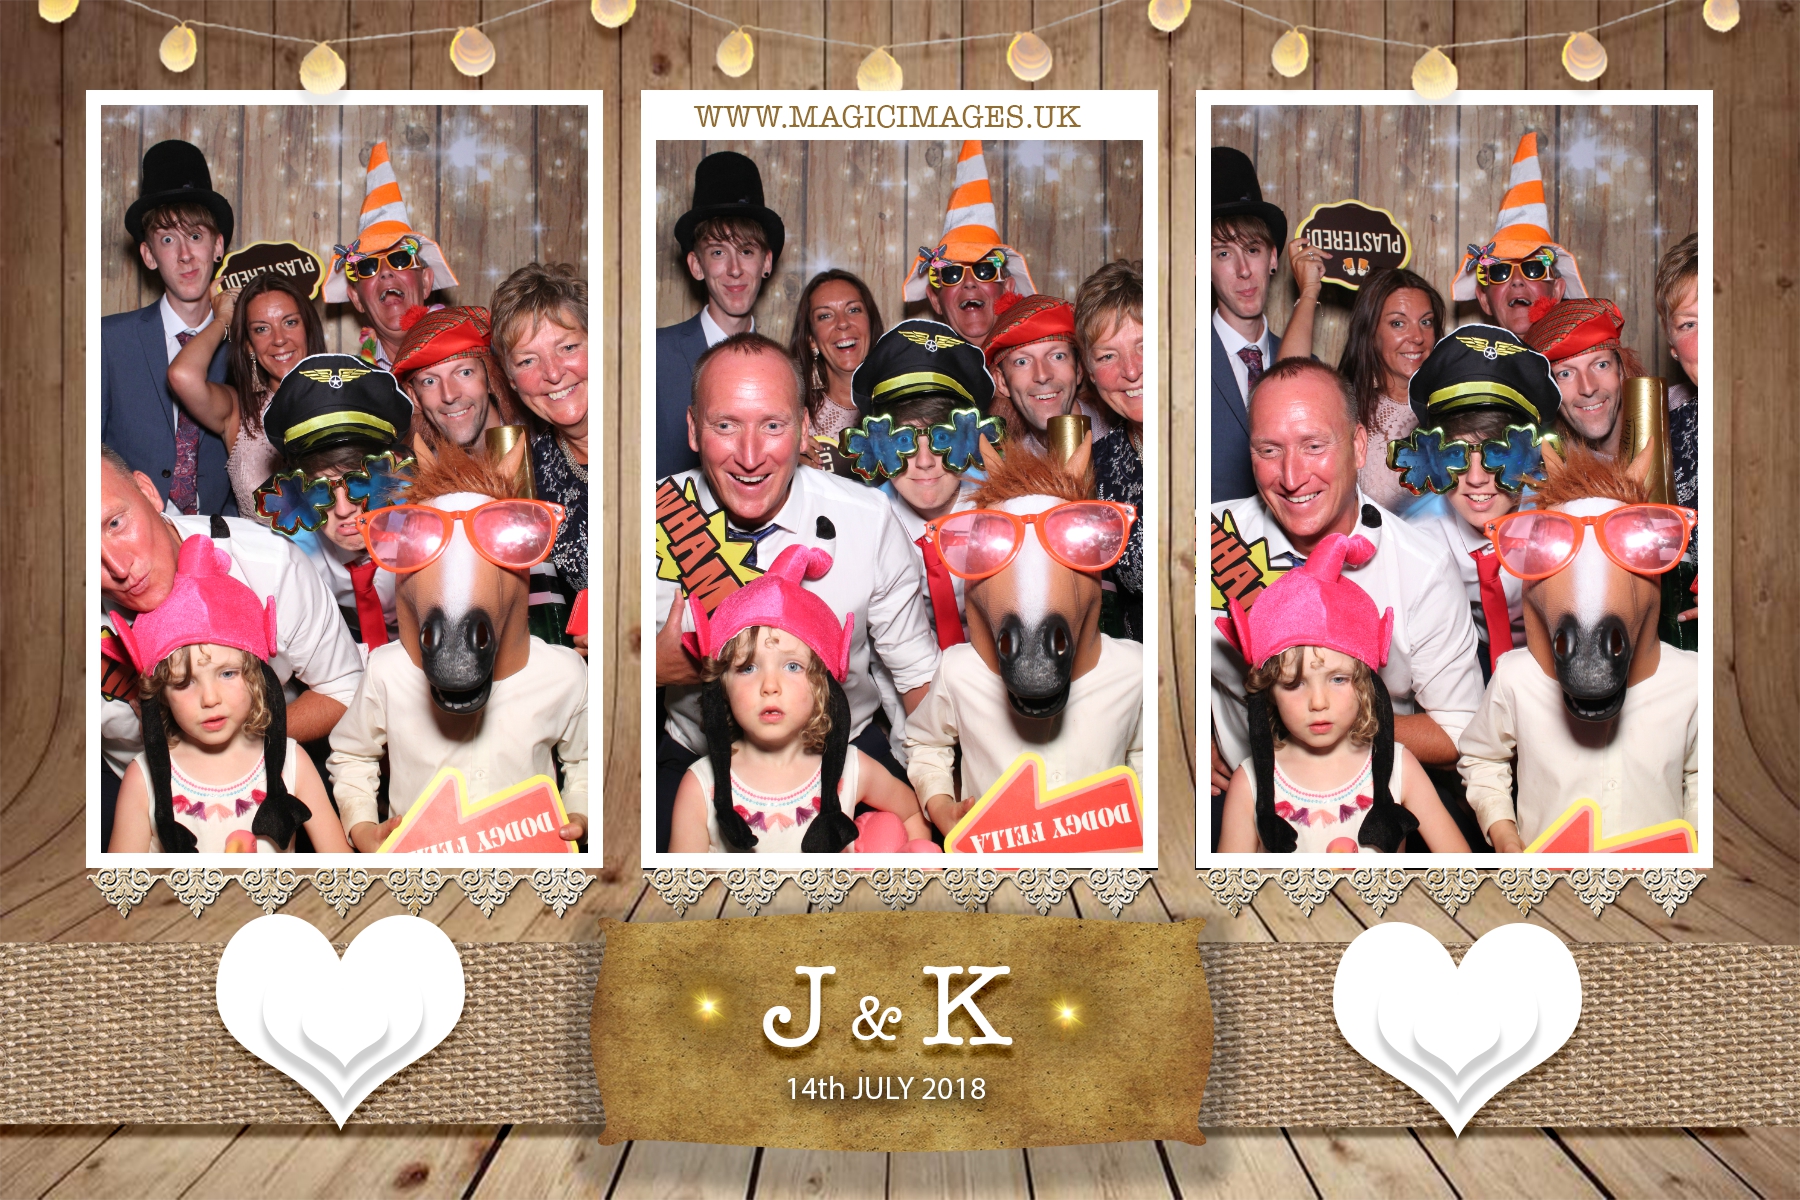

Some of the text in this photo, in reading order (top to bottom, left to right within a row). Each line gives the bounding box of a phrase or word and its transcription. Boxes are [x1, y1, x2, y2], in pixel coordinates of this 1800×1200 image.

[1306, 228, 1402, 254] PLASTERED!
[656, 480, 742, 614] WHAM
[477, 811, 556, 853] DODGY
[970, 803, 1132, 854] DODGY FELLA
